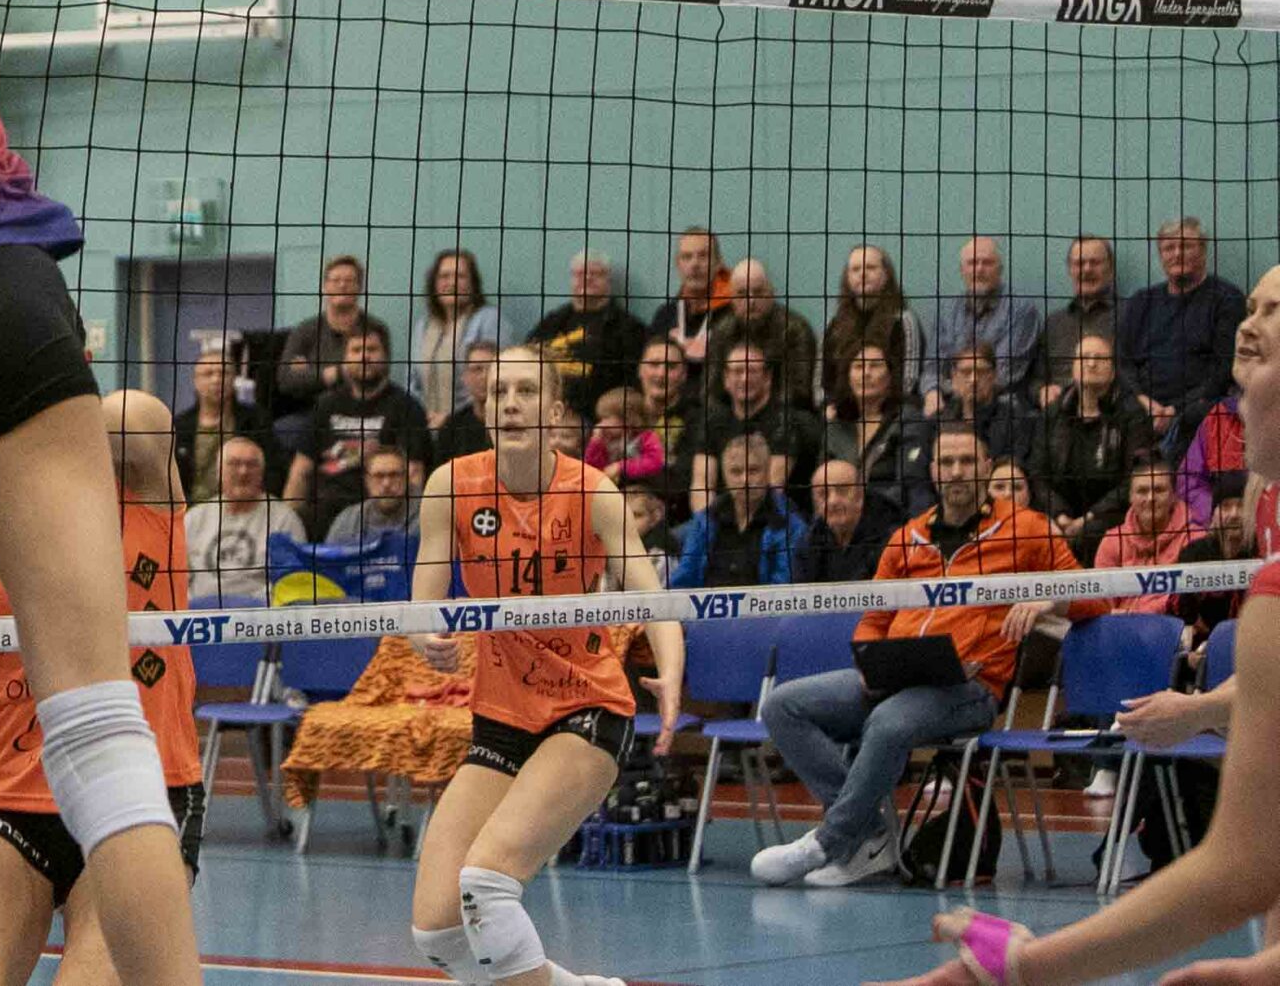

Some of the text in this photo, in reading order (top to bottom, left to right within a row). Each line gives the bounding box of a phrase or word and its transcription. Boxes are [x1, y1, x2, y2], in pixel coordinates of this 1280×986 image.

[510, 547, 543, 596] 14
[1134, 569, 1183, 595] YBT
[1185, 572, 1235, 589] Parasta
[689, 592, 888, 620] YBT Parasta Betonista.
[921, 580, 1104, 608] YBT Parasta Betonista.
[163, 614, 400, 646] YBT Parasta Betonista.
[438, 604, 655, 633] YBT Parasta Betonista.
